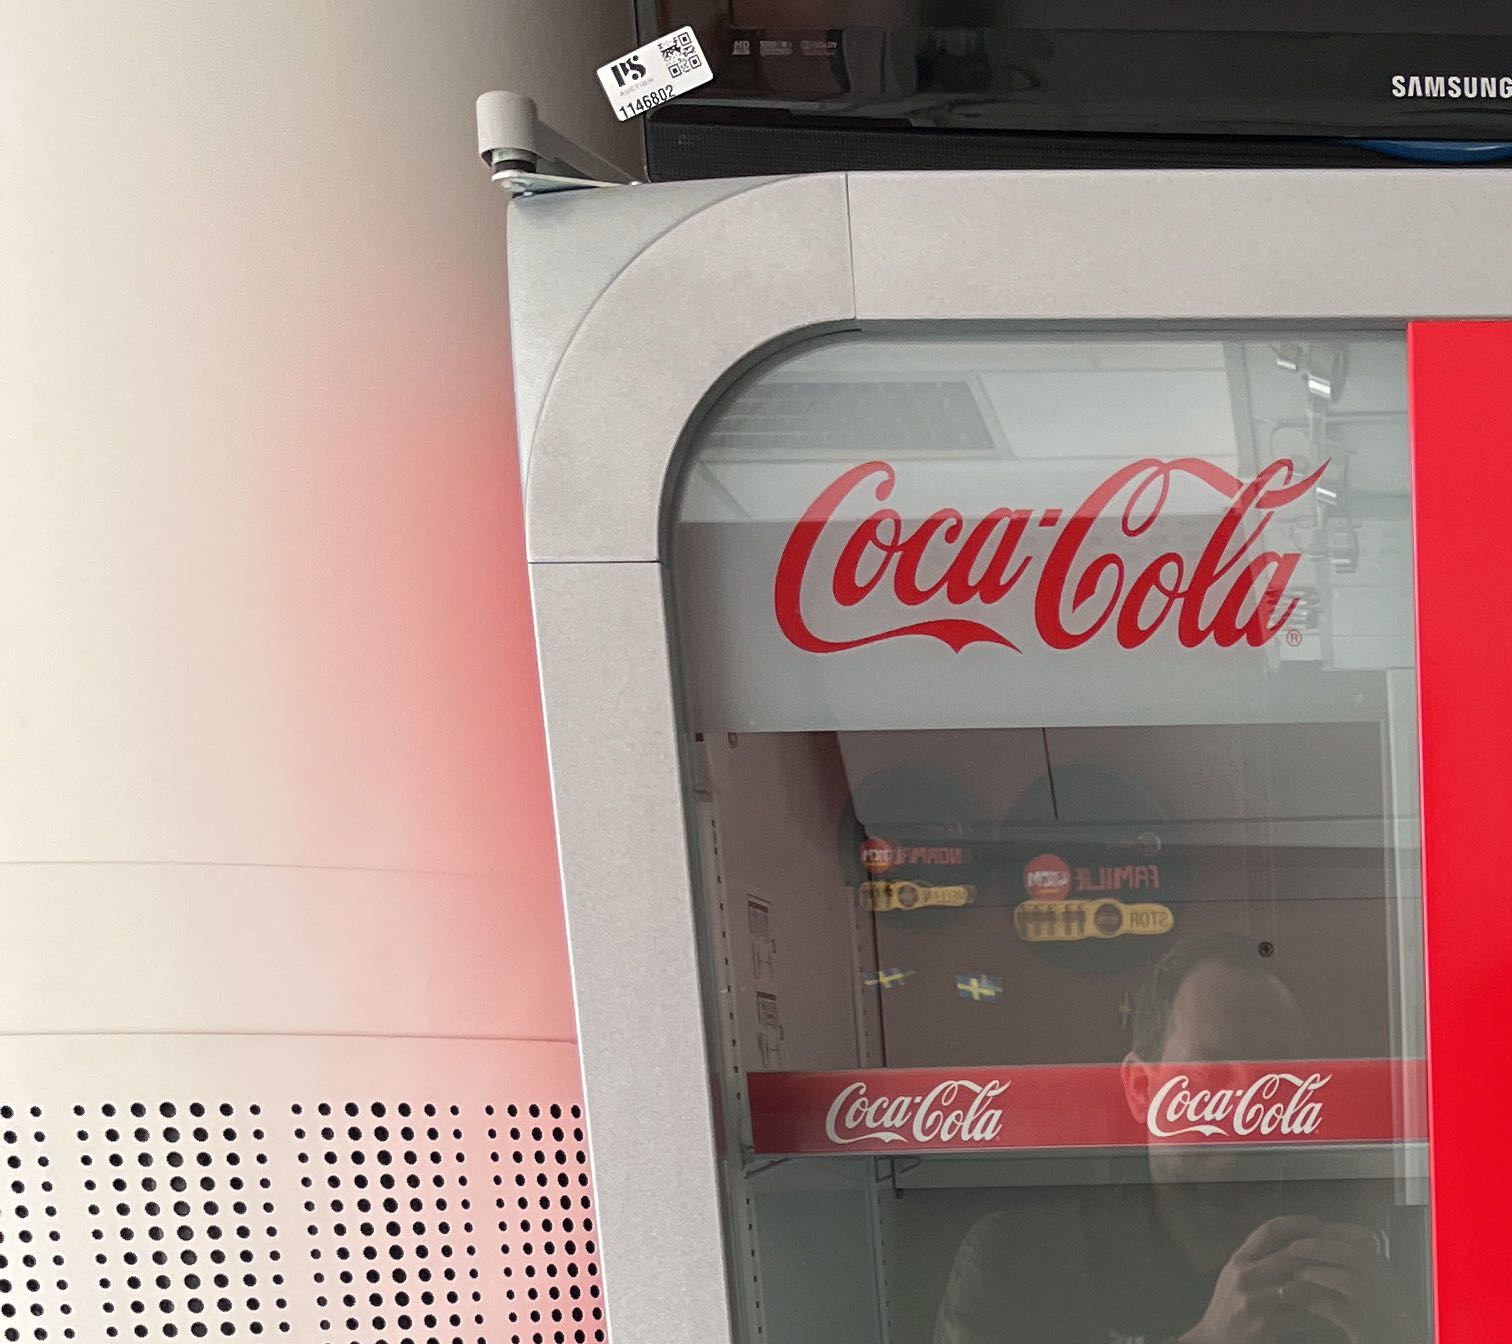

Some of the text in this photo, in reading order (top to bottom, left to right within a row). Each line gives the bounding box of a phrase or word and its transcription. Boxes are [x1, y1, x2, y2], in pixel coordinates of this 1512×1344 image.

[618, 84, 676, 119] 1146802
[619, 77, 654, 97] AUCTION
[774, 456, 1331, 655] Coca-Cola
[825, 1080, 1011, 1145] Coca-Cola
[1146, 1073, 1333, 1139] Coca-Cola
